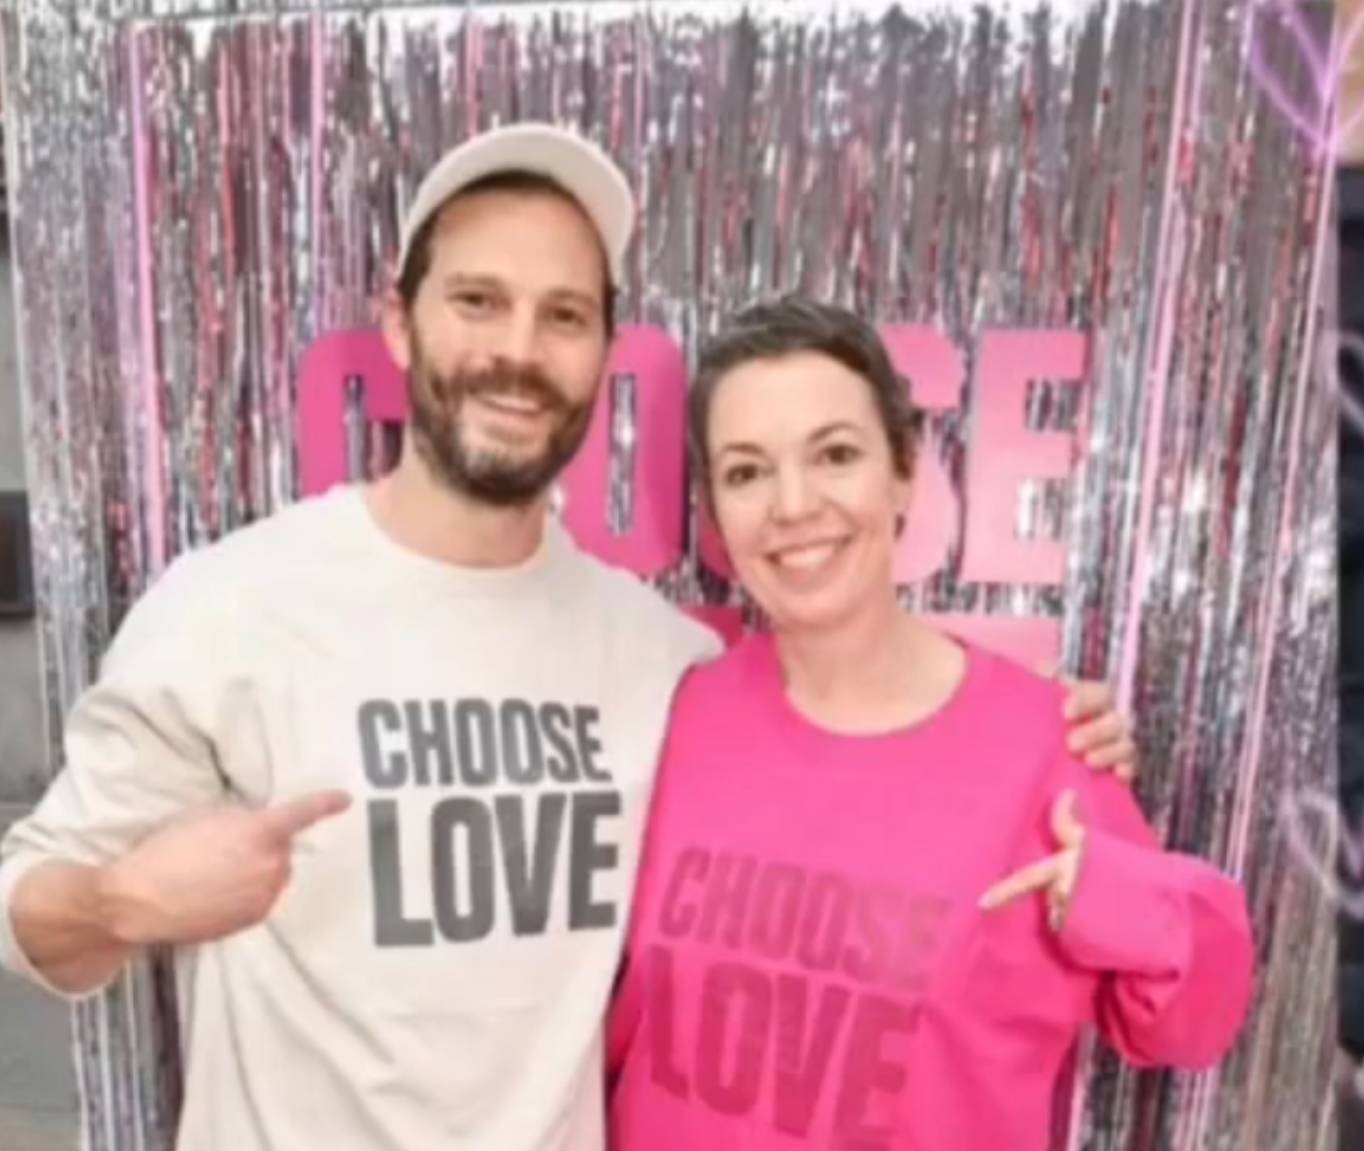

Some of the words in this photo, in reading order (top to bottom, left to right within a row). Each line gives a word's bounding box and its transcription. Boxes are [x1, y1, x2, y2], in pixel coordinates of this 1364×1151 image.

[357, 698, 613, 790] CHOOSE
[366, 790, 623, 948] LOVE
[656, 846, 952, 991] CHOOSE
